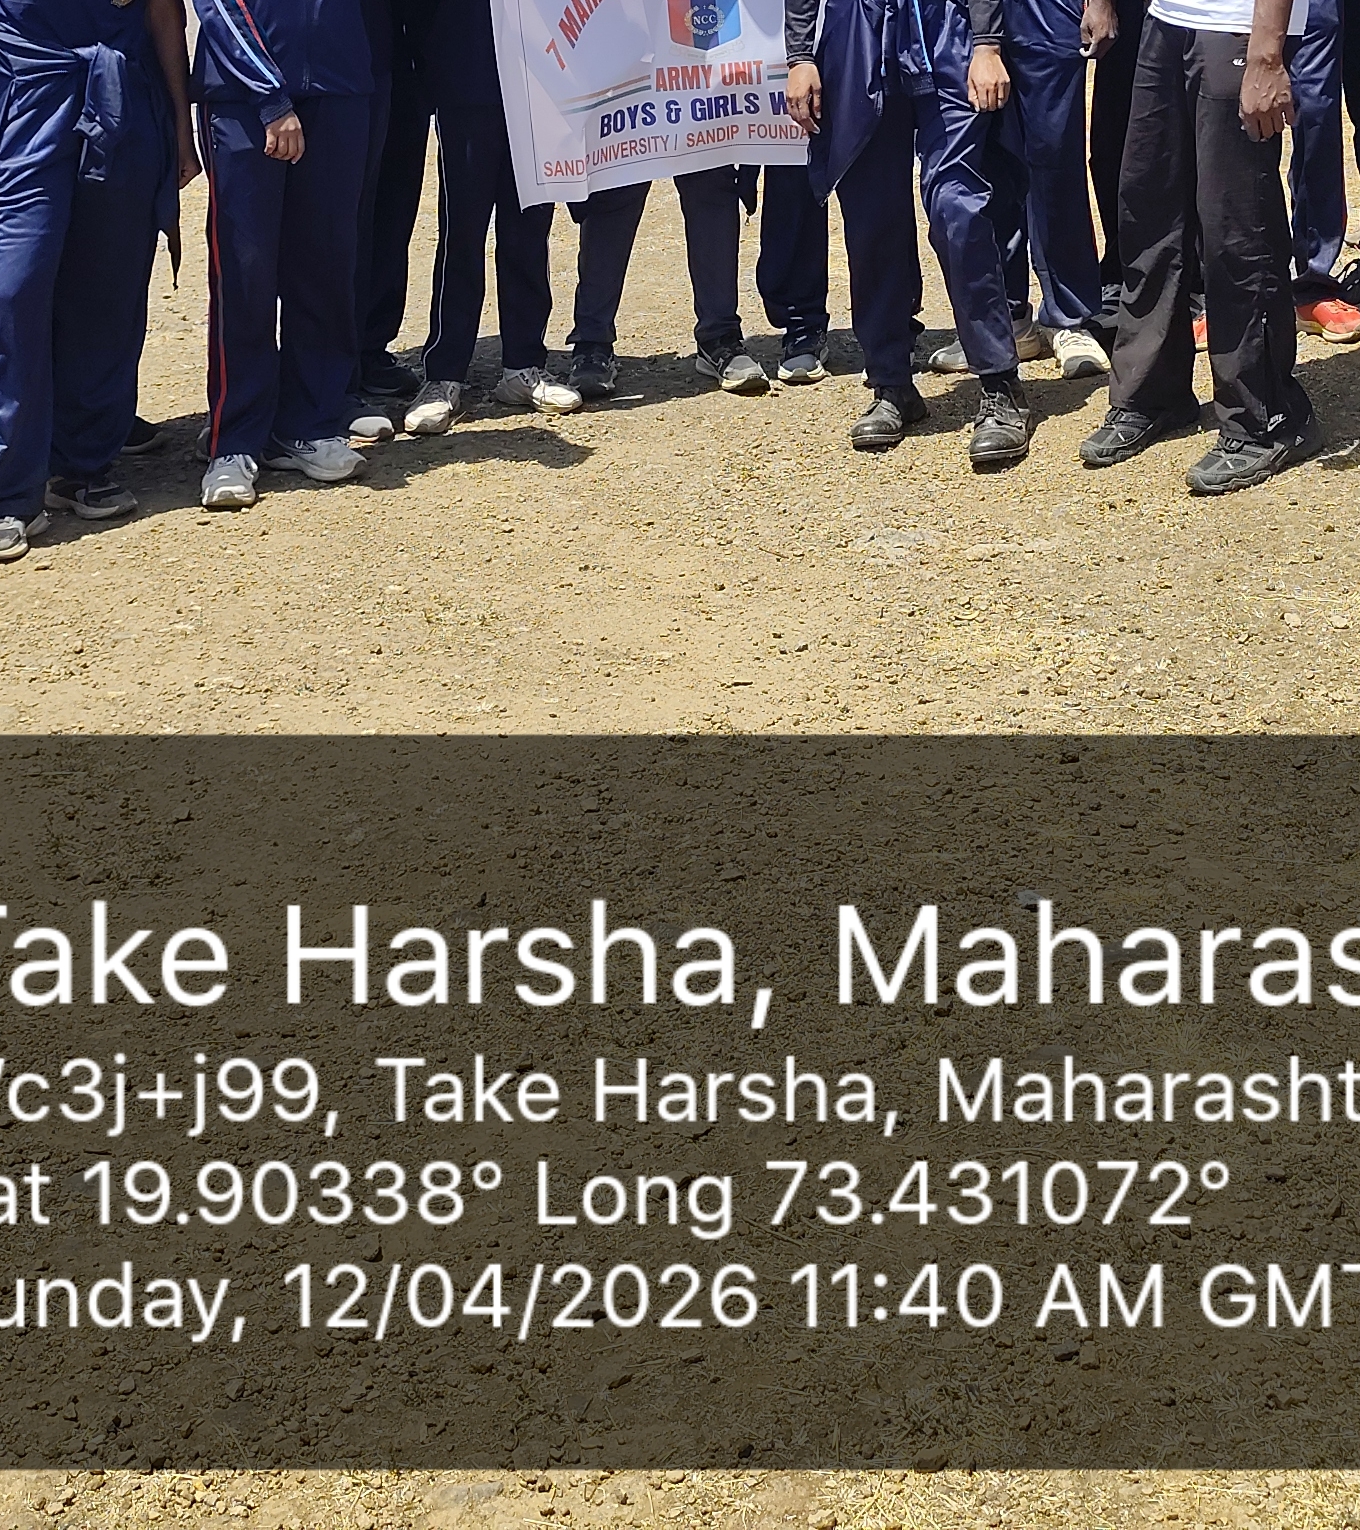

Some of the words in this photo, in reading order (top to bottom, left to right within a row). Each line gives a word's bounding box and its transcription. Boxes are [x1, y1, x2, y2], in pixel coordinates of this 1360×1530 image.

[692, 14, 717, 26] NCC
[544, 37, 567, 71] 7
[655, 64, 713, 92] ARMY
[720, 60, 763, 87] UNIT
[599, 101, 657, 139] BOYS
[665, 99, 682, 124] &
[691, 92, 760, 122] GIRLS
[543, 154, 590, 177] SANDP
[686, 124, 740, 148] SANDIP
